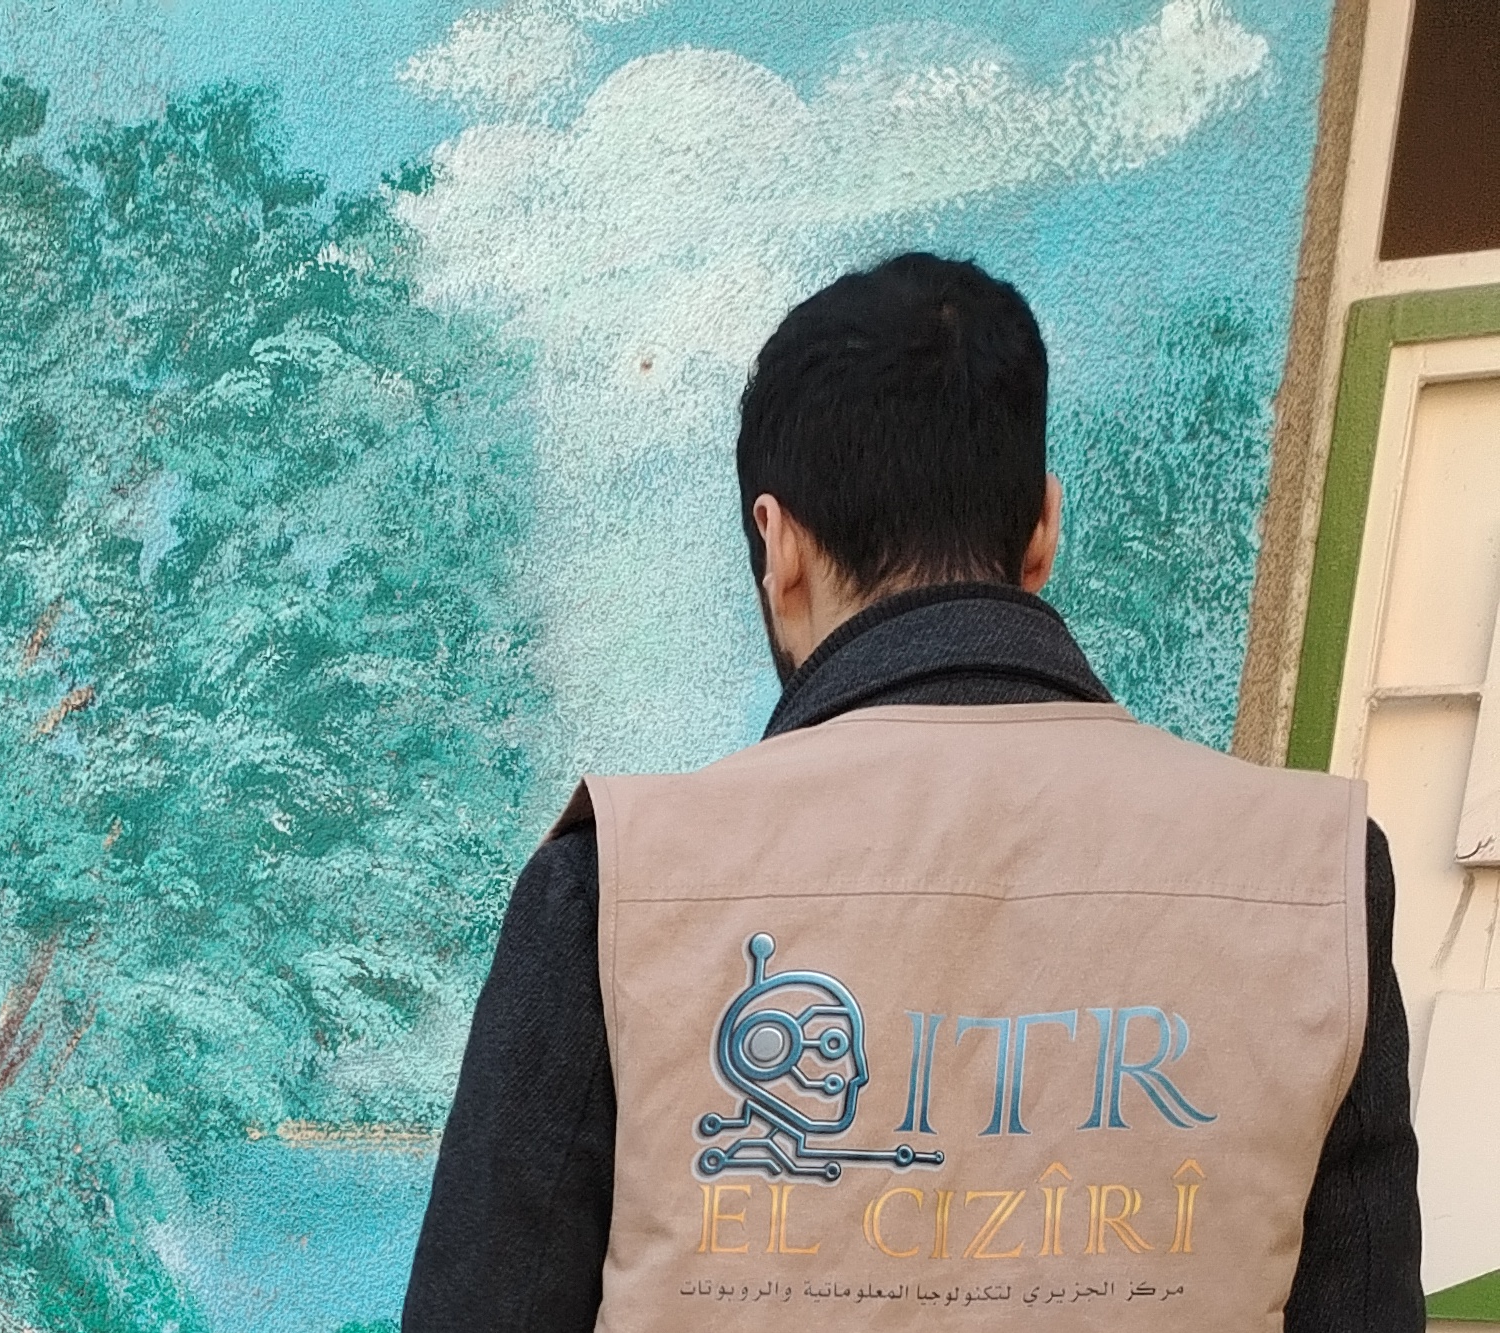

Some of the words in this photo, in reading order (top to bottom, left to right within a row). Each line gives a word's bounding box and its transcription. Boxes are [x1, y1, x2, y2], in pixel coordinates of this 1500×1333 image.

[893, 1006, 1219, 1137] ITR
[697, 1184, 820, 1256] EL
[861, 1158, 1207, 1261] CIZÎRÎ
[679, 1279, 793, 1303] والروبوتات
[802, 1279, 909, 1305] المعلوماتية
[916, 1282, 1012, 1308] لتكنولوجيا
[1022, 1280, 1116, 1307] الجزيري
[1124, 1280, 1185, 1303] مركز
